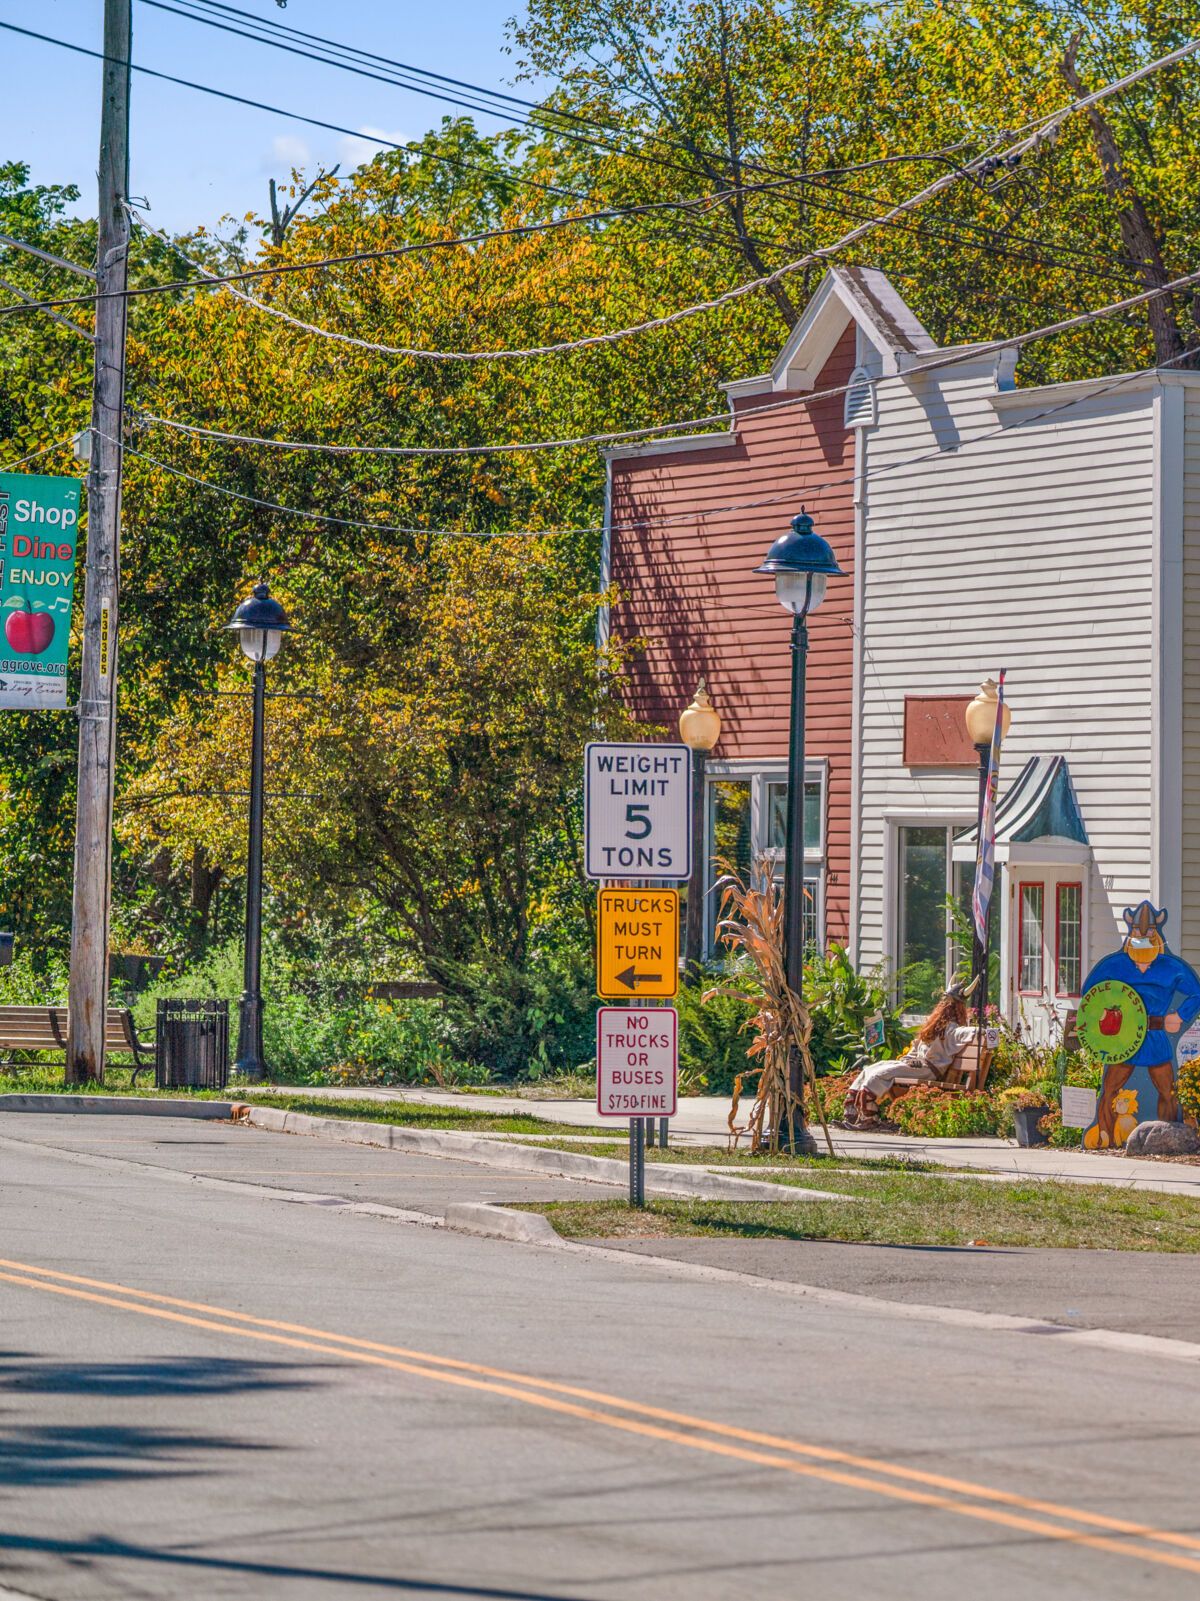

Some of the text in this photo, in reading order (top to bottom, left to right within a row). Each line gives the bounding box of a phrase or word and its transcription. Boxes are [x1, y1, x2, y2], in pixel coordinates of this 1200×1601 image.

[14, 499, 77, 530] Shop
[13, 535, 73, 561] Dine
[10, 568, 73, 587] ENJOY
[101, 609, 109, 674] 530385
[1, 659, 66, 675] ggrove.org
[597, 755, 682, 774] WEIGHT
[610, 779, 669, 796] LIMIT
[624, 804, 652, 840] 5
[602, 846, 673, 867] TONS
[603, 898, 674, 913] TRUCKS
[614, 922, 663, 936] MUST
[614, 945, 662, 960] TURN
[1081, 982, 1144, 1014] APPLE FEST
[627, 1016, 648, 1030] NO
[606, 1034, 669, 1048] TRUCKS
[1099, 1024, 1144, 1062] TREASURES
[627, 1052, 648, 1066] OR
[612, 1071, 664, 1085] BUSES
[608, 1094, 666, 1110] $750 FINE
